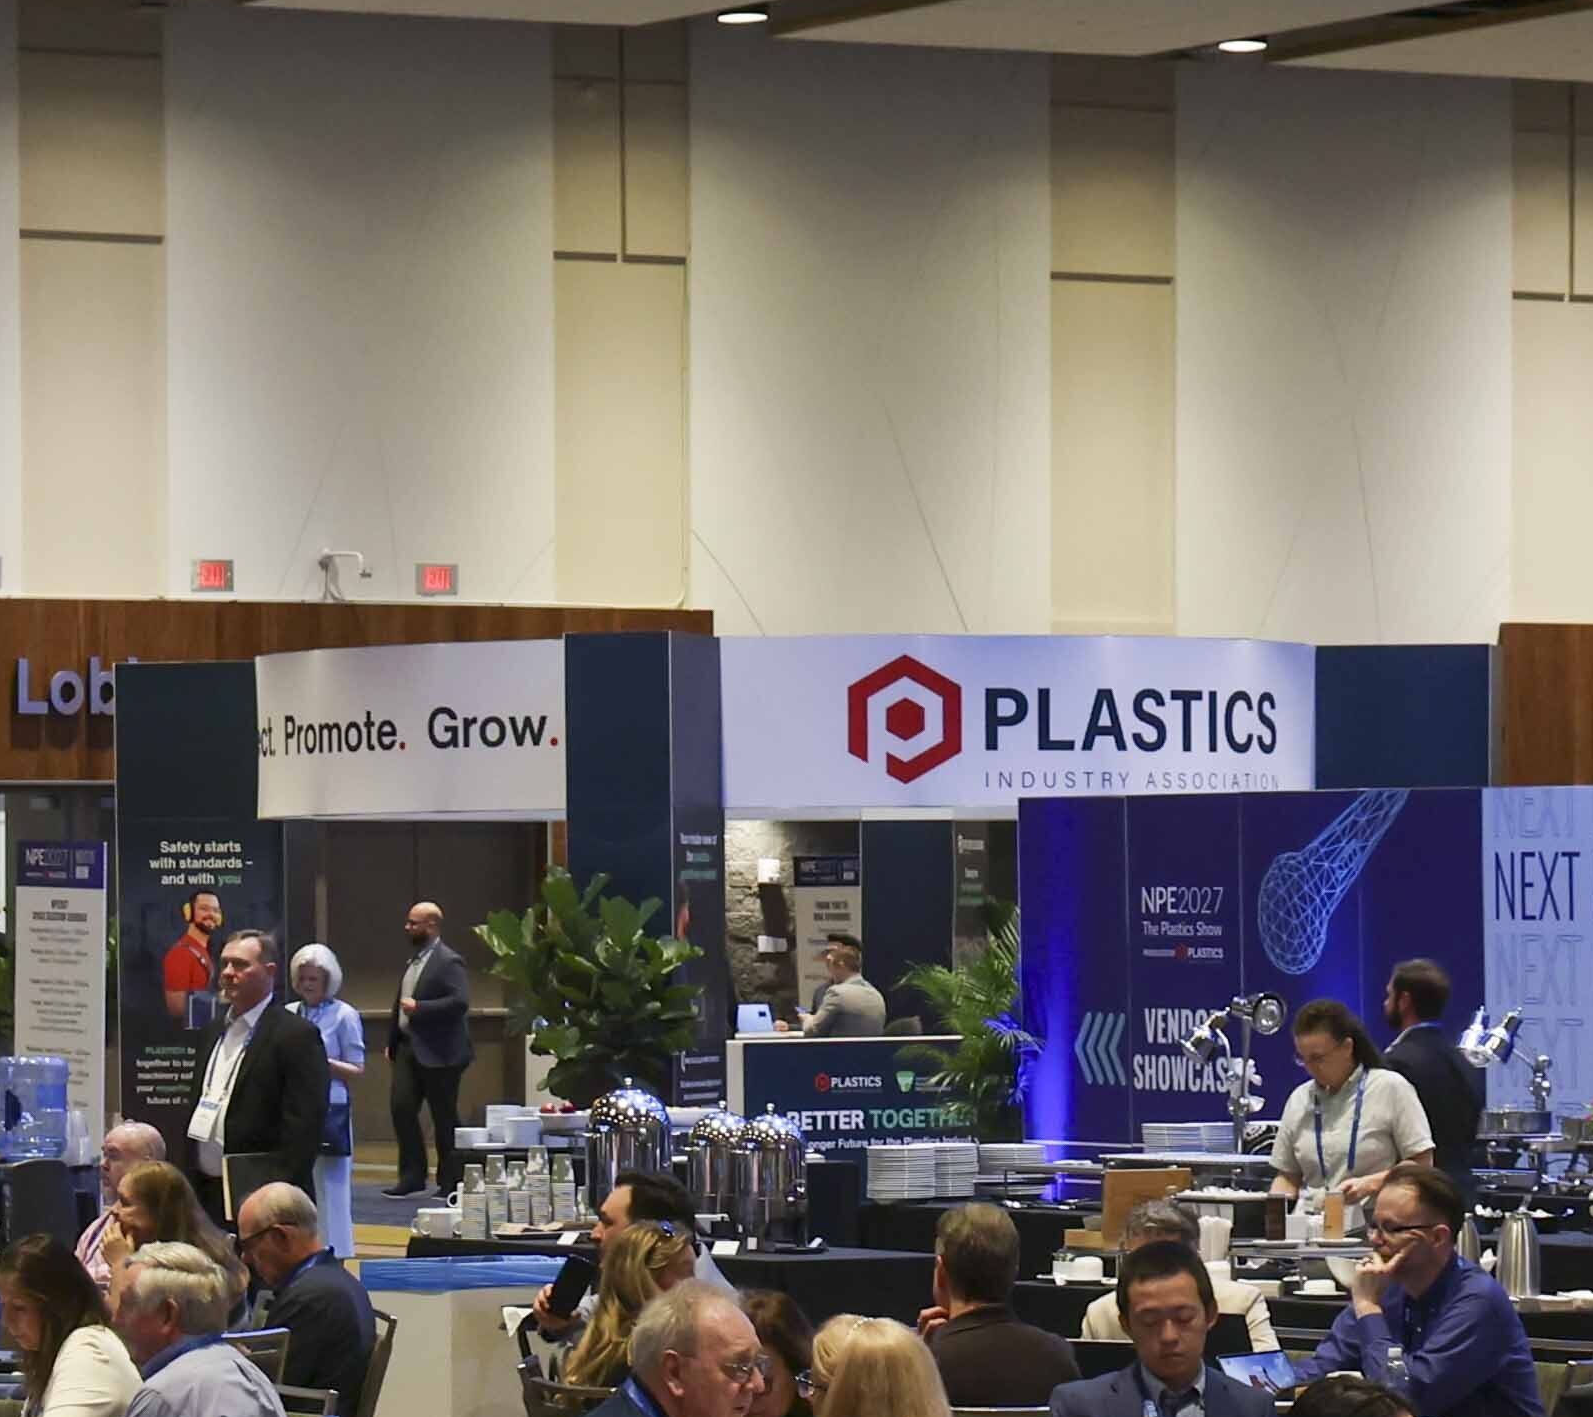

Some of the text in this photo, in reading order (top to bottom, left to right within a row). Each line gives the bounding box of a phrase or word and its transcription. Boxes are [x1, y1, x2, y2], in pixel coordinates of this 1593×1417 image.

[17, 657, 115, 715] Lob
[285, 710, 406, 755] Promote.
[428, 706, 558, 749] Grow.
[984, 688, 1277, 754] PLASTICS
[985, 771, 1279, 790] INDUSTRY ASSOCIATION
[160, 841, 241, 855] Safety starts
[149, 857, 175, 869] with
[179, 857, 243, 869] standards
[161, 873, 241, 887] and with you
[1494, 851, 1580, 921] NEXT
[1141, 886, 1223, 914] NPE2027
[1143, 921, 1222, 936] The Plastics Show
[1144, 1008, 1224, 1044] VENDO
[831, 1076, 882, 1088] PLASTICS
[1133, 1054, 1229, 1093] SHOWCAS
[786, 1110, 864, 1131] BETTER
[807, 1140, 836, 1152] onger
[838, 1137, 869, 1149] Future
